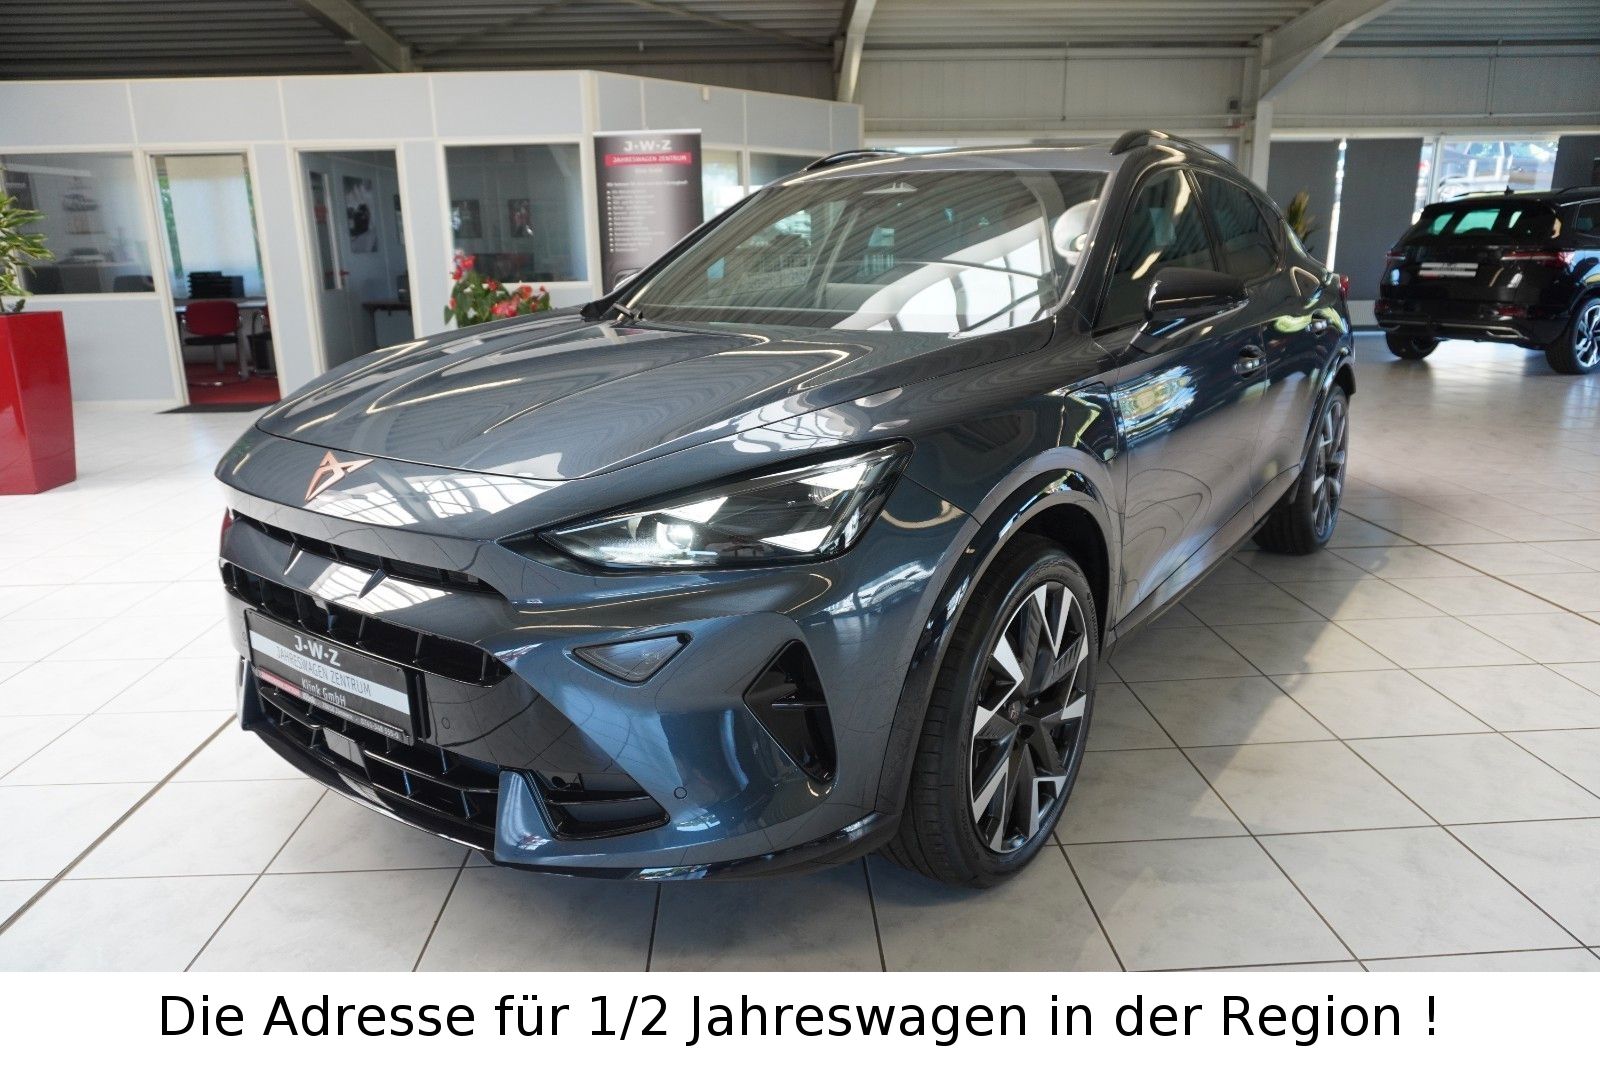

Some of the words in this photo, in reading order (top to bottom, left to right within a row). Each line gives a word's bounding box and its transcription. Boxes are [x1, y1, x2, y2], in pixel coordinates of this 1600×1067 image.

[658, 154, 687, 162] ZENTRUM
[275, 645, 329, 681] JAHRESWAGEN
[330, 670, 372, 697] ZENTRUM
[322, 687, 347, 707] GmbH
